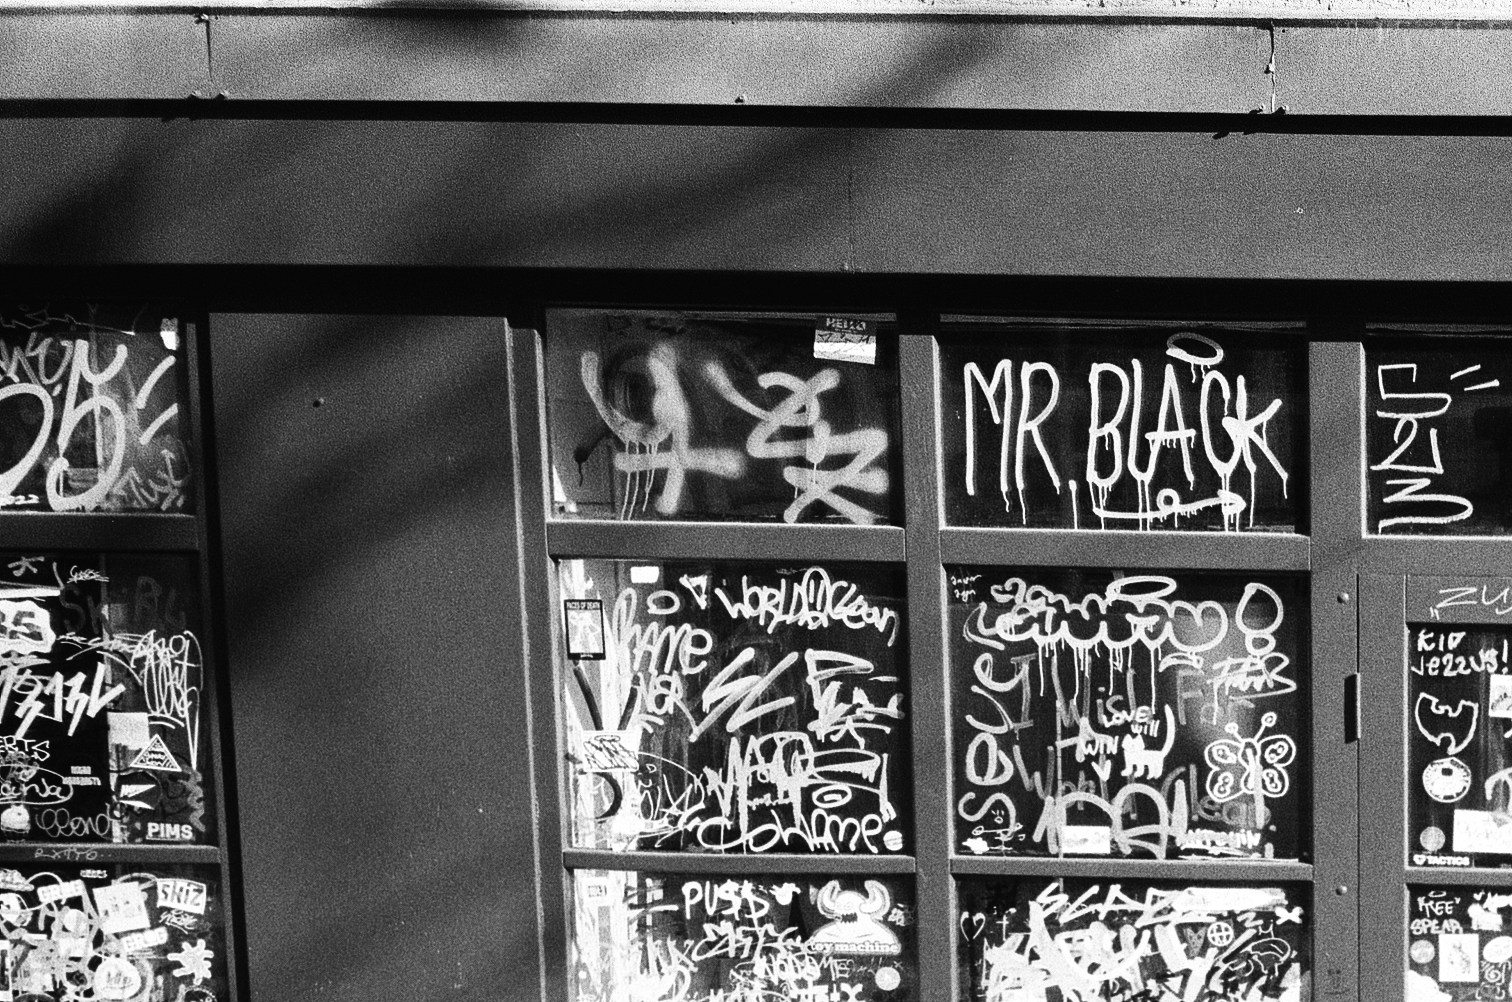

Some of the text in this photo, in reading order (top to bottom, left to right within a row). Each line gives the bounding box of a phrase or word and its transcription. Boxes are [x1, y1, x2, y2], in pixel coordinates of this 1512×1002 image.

[1086, 358, 1289, 495] BLACK
[147, 822, 194, 839] PIMS
[1427, 855, 1470, 867] TACTICS
[835, 942, 899, 953] machine
